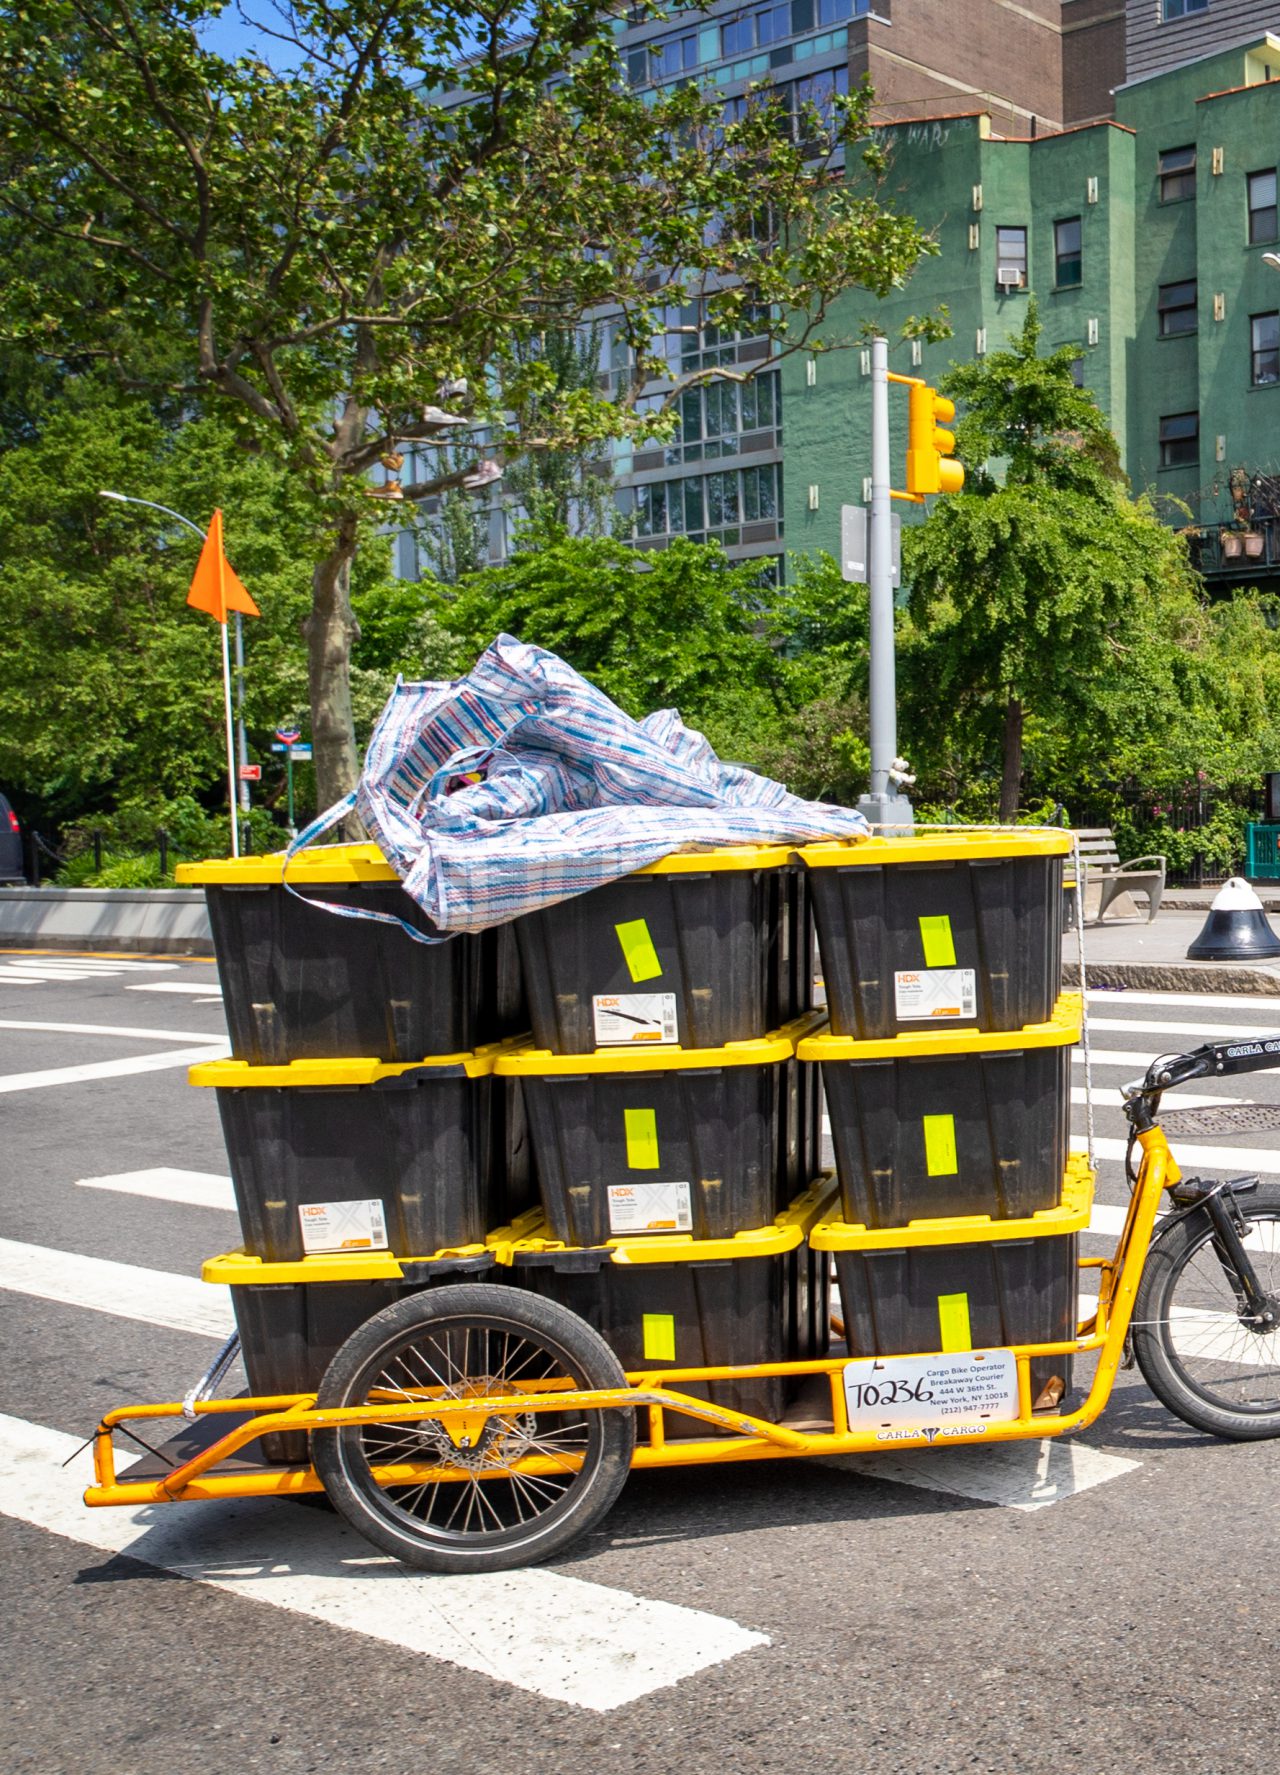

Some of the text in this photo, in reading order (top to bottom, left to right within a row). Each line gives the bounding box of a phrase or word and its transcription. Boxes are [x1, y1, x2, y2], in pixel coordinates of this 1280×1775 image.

[897, 974, 920, 983] HDX
[596, 998, 620, 1007] HDX
[1228, 1044, 1263, 1057] CARLA
[611, 1187, 635, 1197] HDX
[303, 1206, 327, 1216] HDX
[926, 1363, 1006, 1378] Cargo Bike Operator
[930, 1373, 1004, 1387] Breakaway Courier
[956, 1386, 966, 1394] W
[967, 1384, 985, 1393] 36th
[986, 1383, 997, 1391] St.
[950, 1396, 970, 1404] York,
[971, 1394, 983, 1402] NY
[984, 1391, 1009, 1400] 10018
[941, 1402, 999, 1416] (212) 947-7777
[877, 1424, 987, 1441] CARLA CARGO
